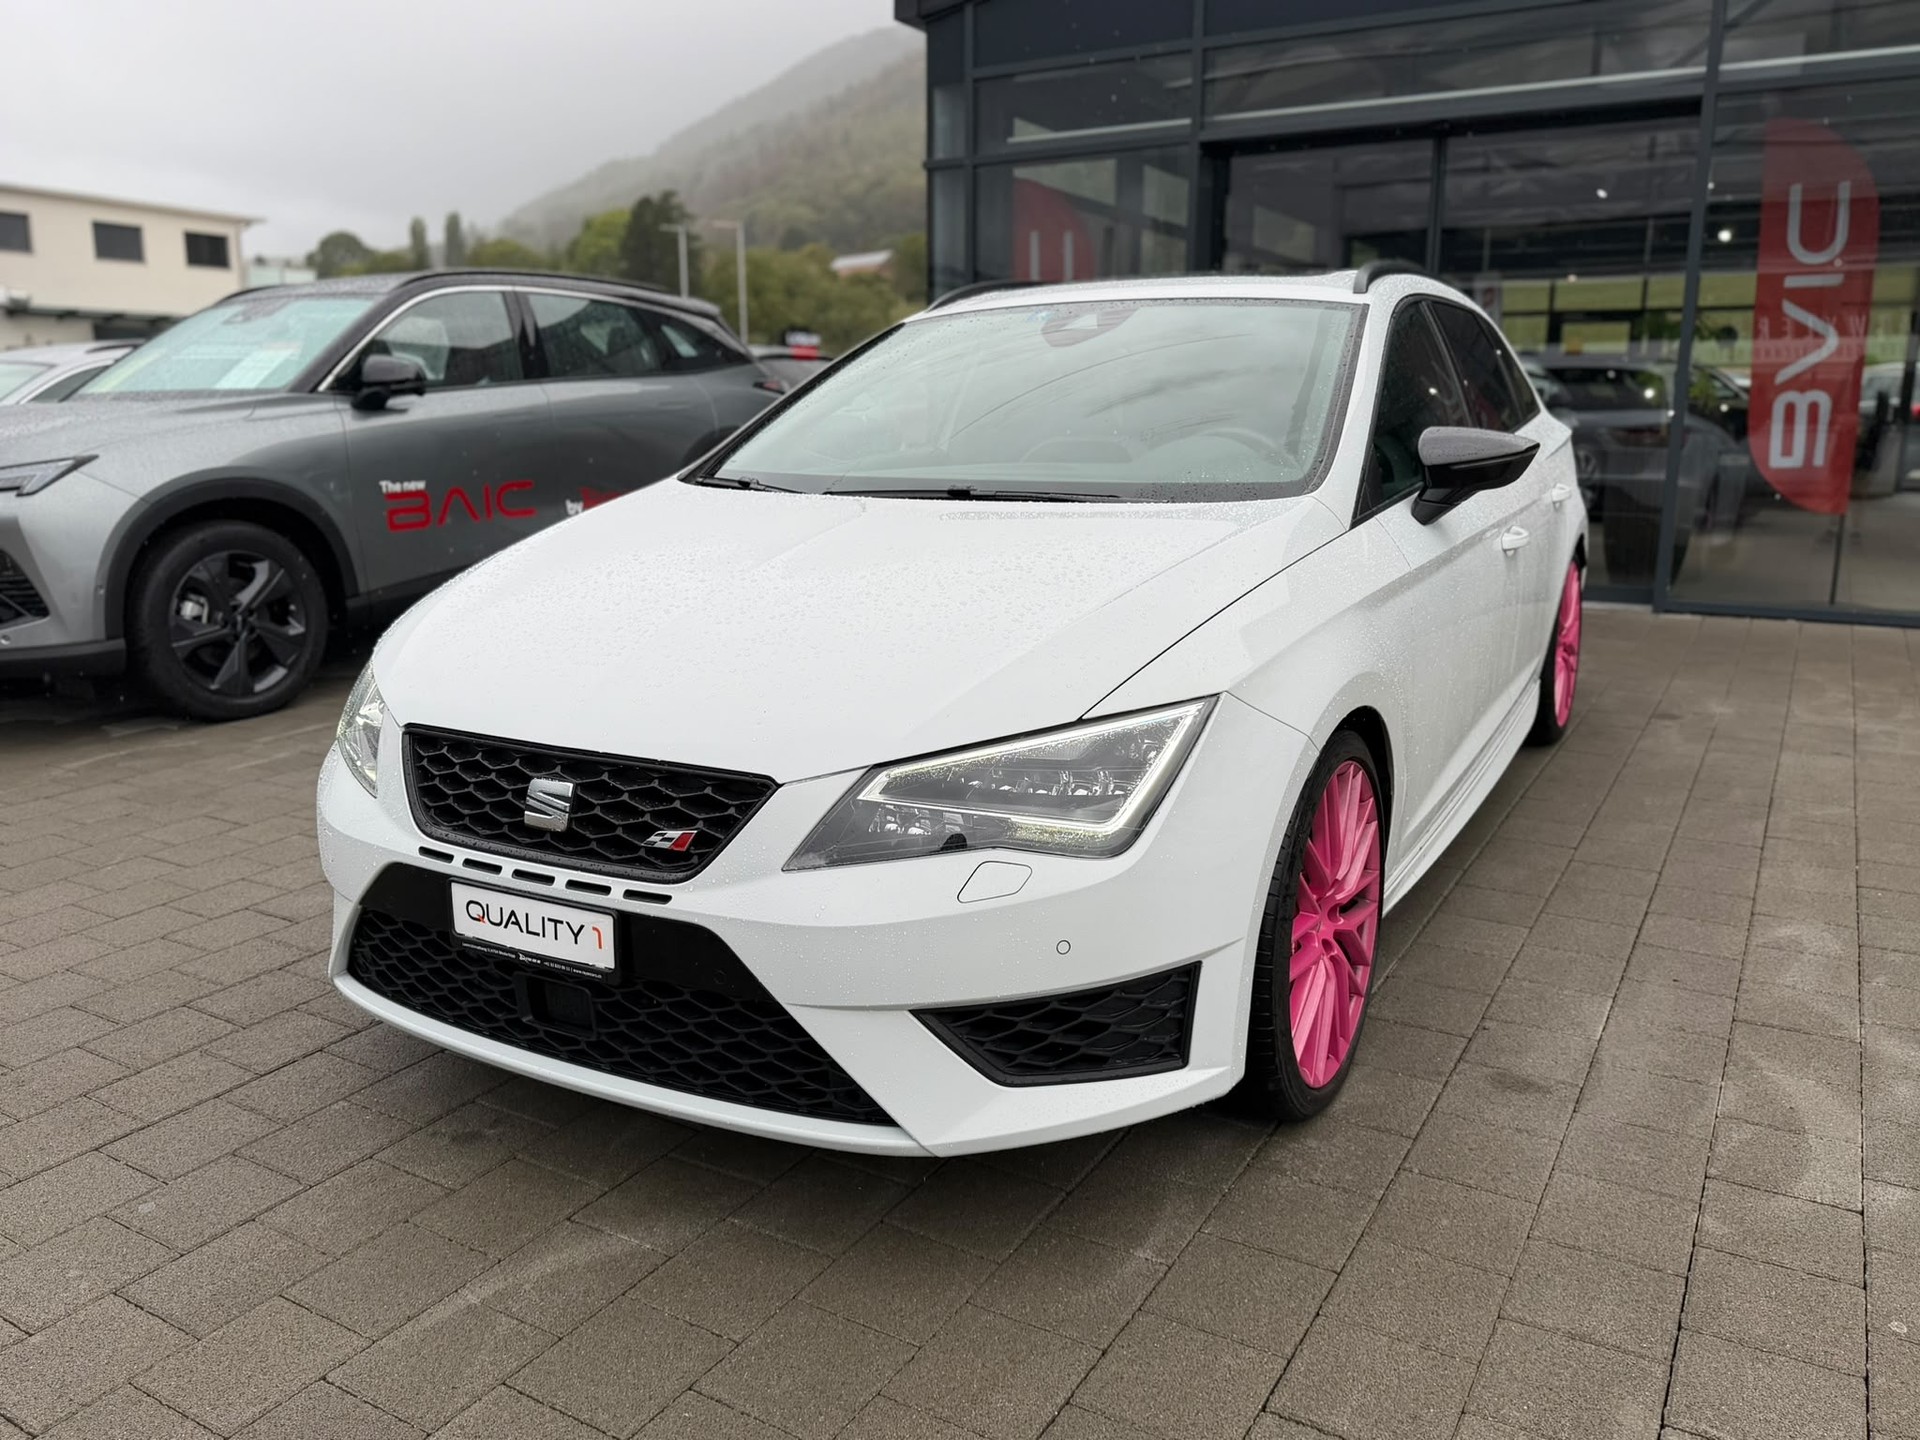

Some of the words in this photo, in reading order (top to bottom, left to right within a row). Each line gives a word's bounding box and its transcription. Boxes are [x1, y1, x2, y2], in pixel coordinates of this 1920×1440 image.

[379, 480, 402, 493] The
[402, 480, 426, 491] new
[384, 480, 536, 532] BAIC
[466, 900, 585, 945] QUALITY
